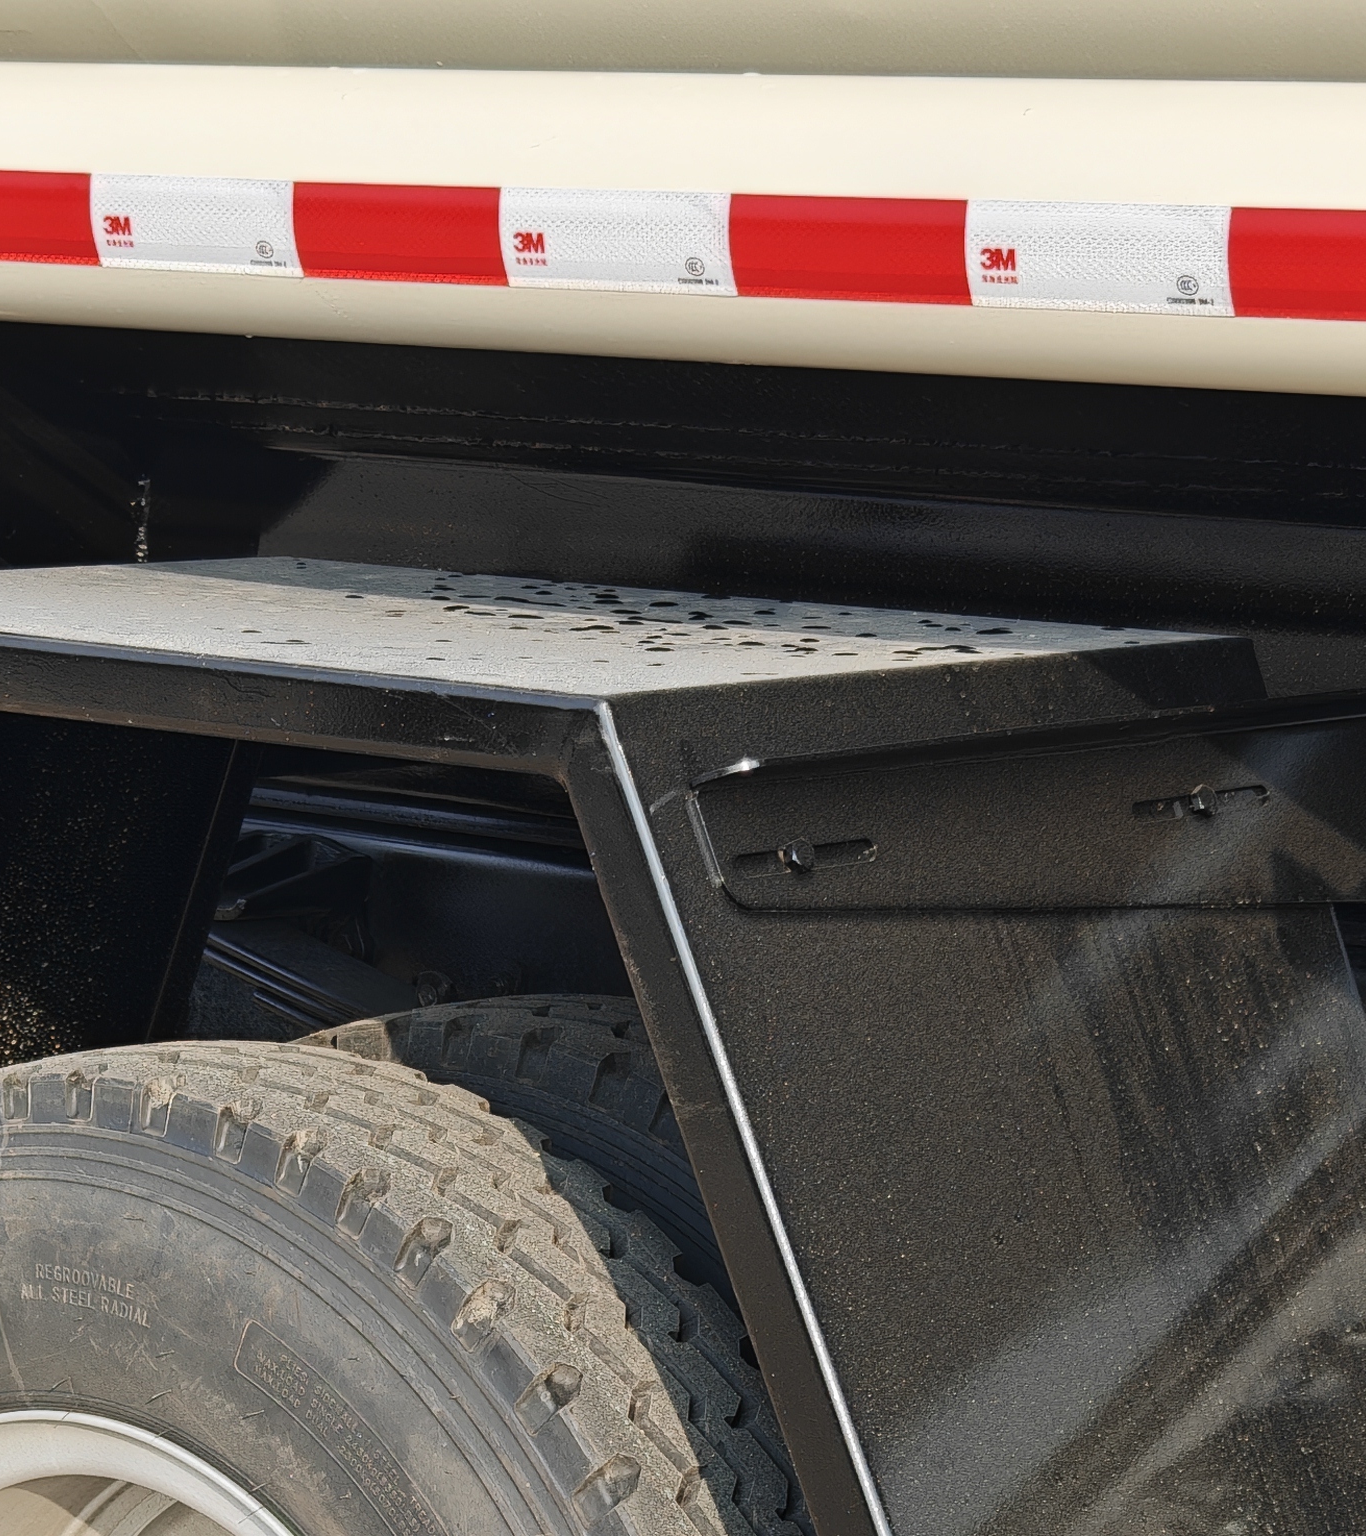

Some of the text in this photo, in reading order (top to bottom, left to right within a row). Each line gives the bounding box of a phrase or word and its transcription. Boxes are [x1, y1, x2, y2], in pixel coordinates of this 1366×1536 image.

[103, 215, 132, 236] 3M
[513, 232, 546, 254] 3M
[980, 248, 1016, 271] 3M
[35, 1263, 135, 1300] REGROOVABLE
[20, 1282, 151, 1329] ALL STEEL RADIAL
